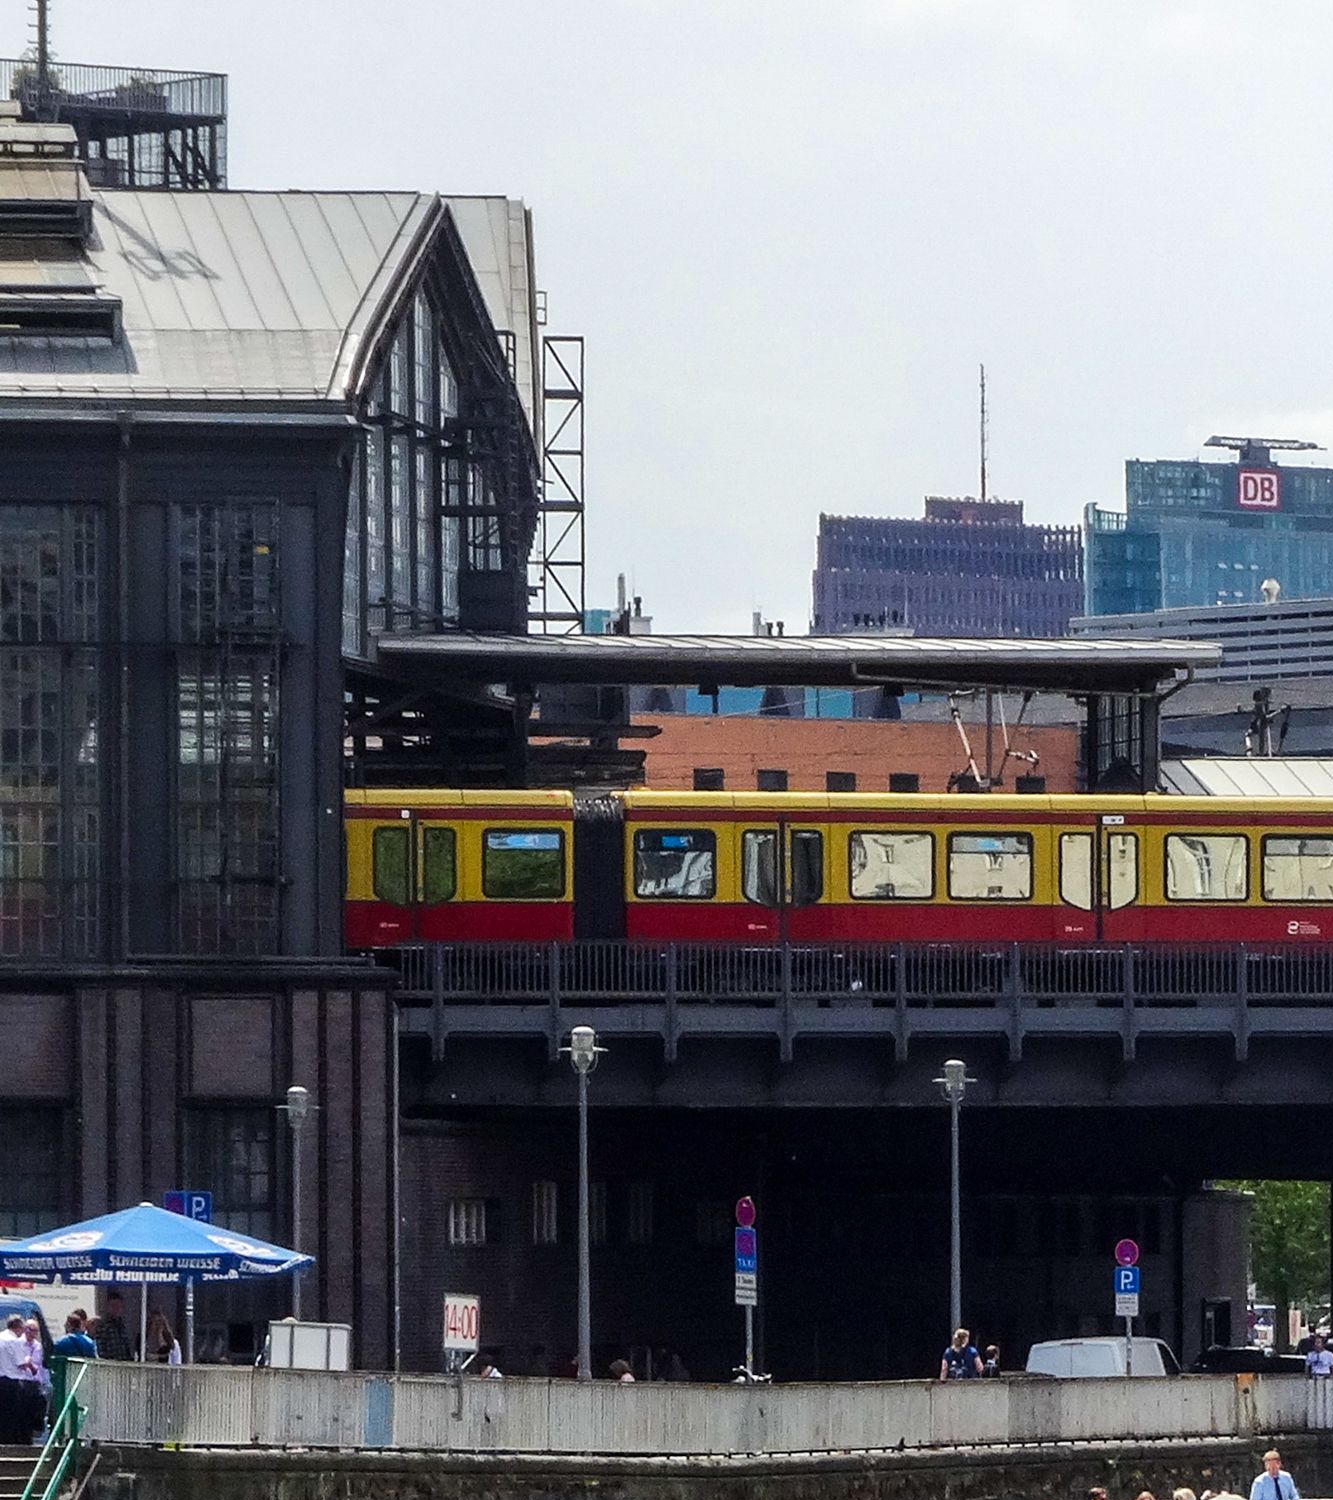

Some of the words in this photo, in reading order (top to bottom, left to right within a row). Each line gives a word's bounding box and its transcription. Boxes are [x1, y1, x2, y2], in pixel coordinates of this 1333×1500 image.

[1243, 475, 1275, 502] DB
[191, 1196, 206, 1217] P
[109, 1254, 174, 1269] SCHNEIDER
[176, 1256, 221, 1270] WEISSE
[1121, 1270, 1133, 1290] P
[445, 1303, 479, 1340] 14:00
